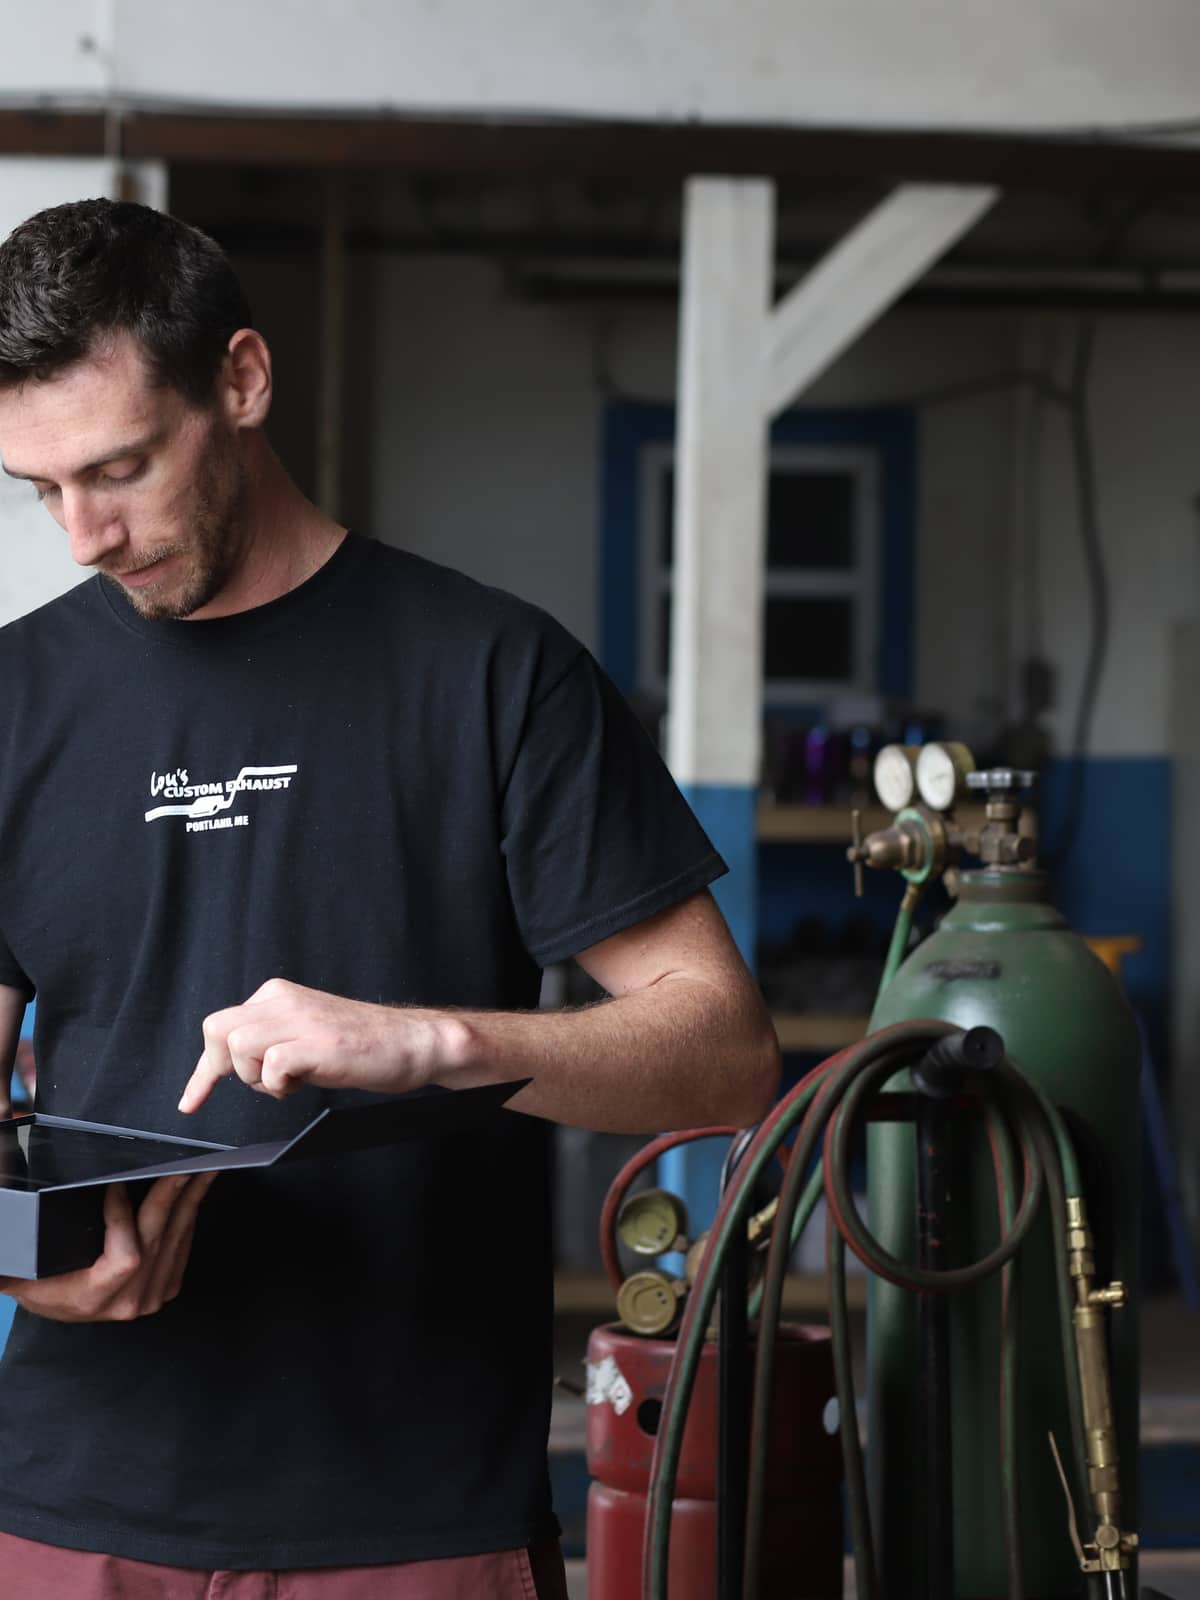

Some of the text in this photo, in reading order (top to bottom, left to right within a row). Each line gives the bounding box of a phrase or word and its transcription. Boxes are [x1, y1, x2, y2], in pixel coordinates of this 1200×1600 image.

[151, 768, 189, 797] Lou's
[164, 777, 291, 798] CUSTOM EXHAUST
[234, 815, 249, 826] ME
